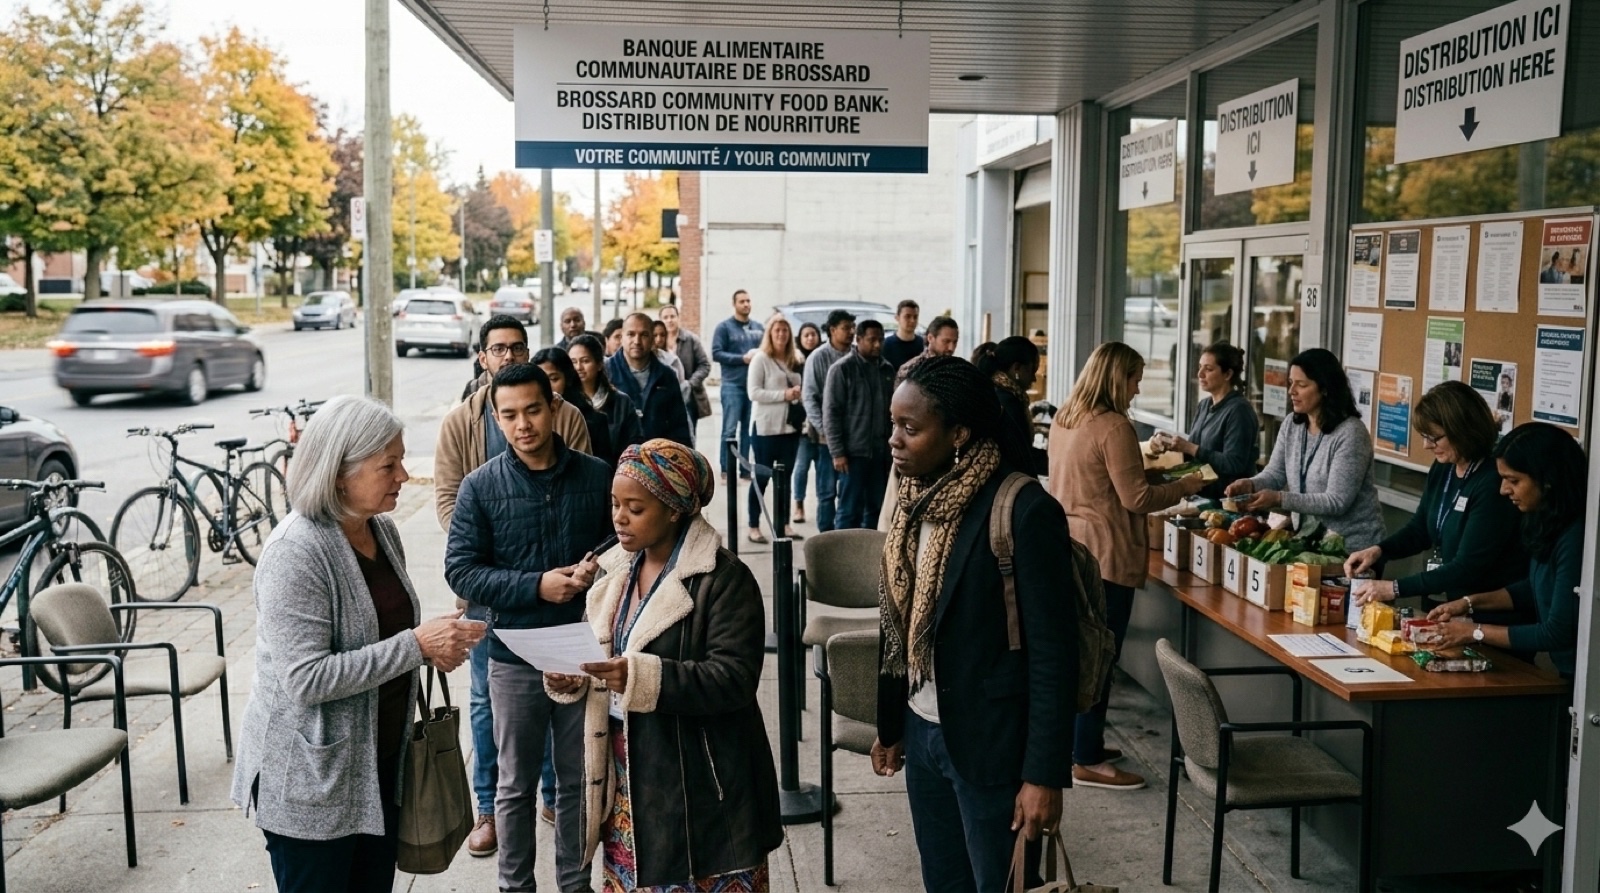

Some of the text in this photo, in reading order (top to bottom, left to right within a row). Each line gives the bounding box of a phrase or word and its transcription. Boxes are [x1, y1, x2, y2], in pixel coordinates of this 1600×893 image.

[623, 39, 825, 60] BANQUE ALIMENTAIRE
[1404, 4, 1561, 79] DISTRIBUTION ICI
[576, 60, 871, 82] COMMUNAUTAIRE DE BROSSARD
[1404, 48, 1556, 111] DISTRIBUTION HERE
[557, 90, 889, 113] BROSSARD COMMUNITY FOOD BANK:
[582, 113, 861, 134] DISTRIBUTION DE NOURRITURE
[1220, 91, 1294, 135] DISTRIBUTION
[1246, 130, 1261, 155] ICI
[574, 147, 871, 167] VOTRE COMMUNITÉ / YOUR COMMUNITY
[1306, 287, 1318, 308] 36
[1167, 533, 1173, 553] 1
[1196, 545, 1203, 567] 3
[1227, 559, 1235, 580] 4
[1251, 570, 1259, 592] 5
